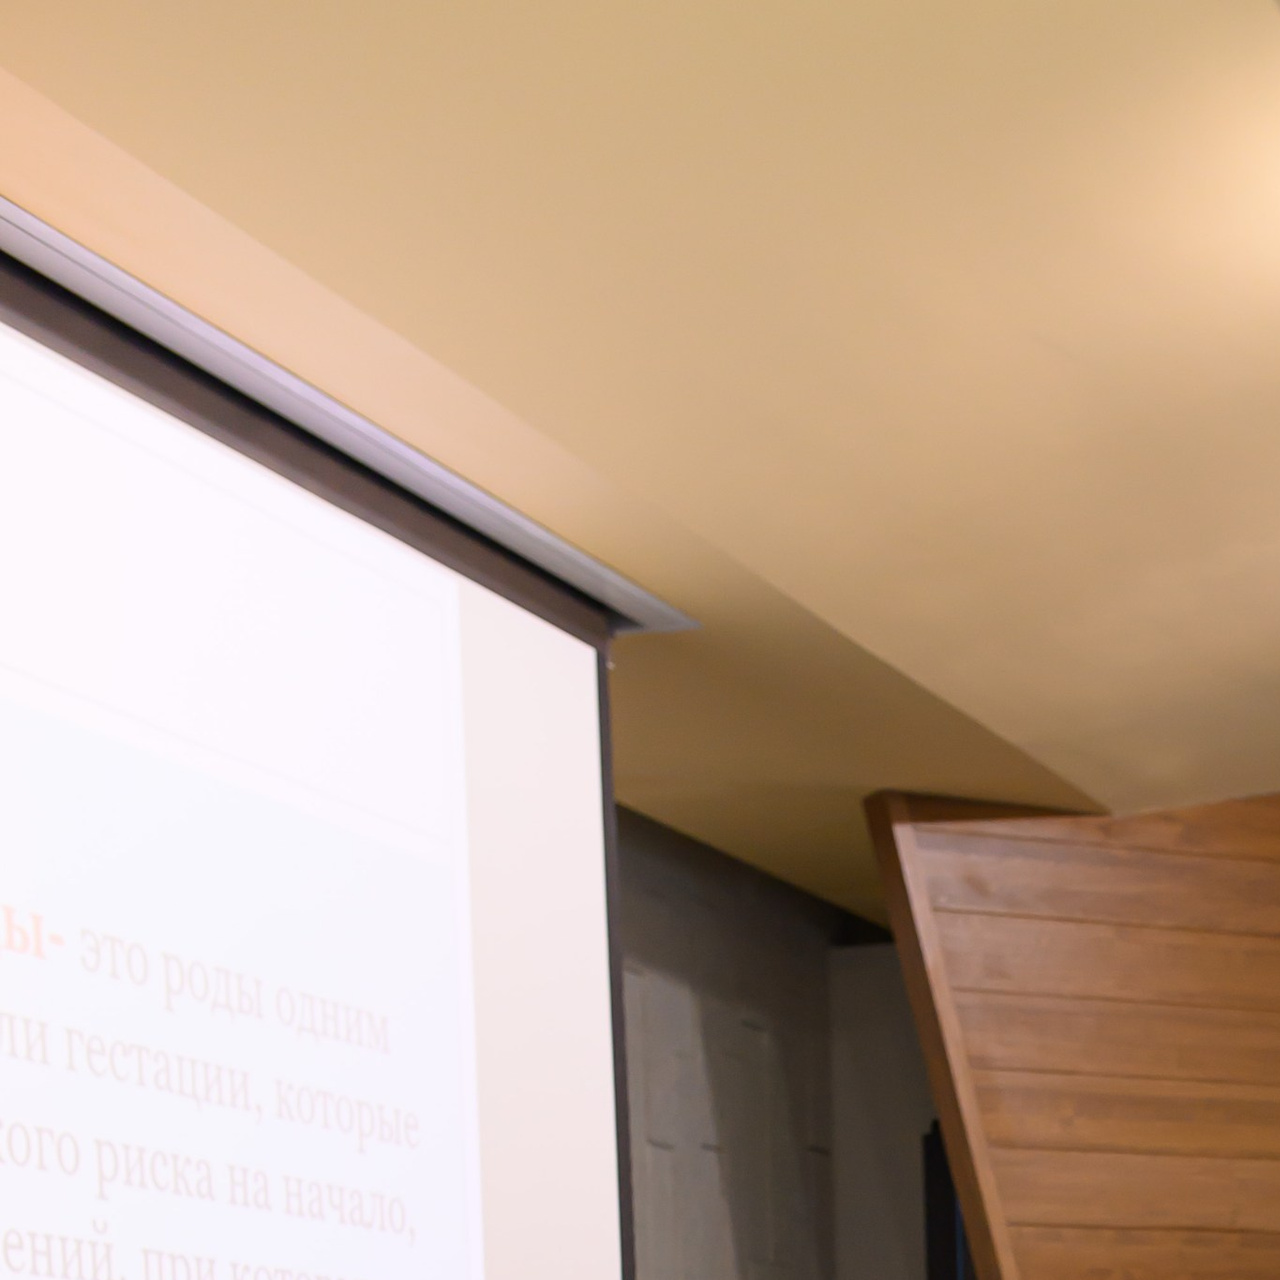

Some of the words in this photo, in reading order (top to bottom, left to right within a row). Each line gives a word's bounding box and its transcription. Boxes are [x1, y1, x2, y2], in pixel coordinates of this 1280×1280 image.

[80, 927, 149, 987] это
[161, 951, 263, 1022] роды
[275, 986, 391, 1055] одним
[66, 1025, 264, 1124] гестации,
[273, 1076, 420, 1153] которые
[0, 1116, 81, 1177] ого
[93, 1137, 215, 1202] риска
[228, 1162, 272, 1212] на
[282, 1173, 417, 1246] начало,
